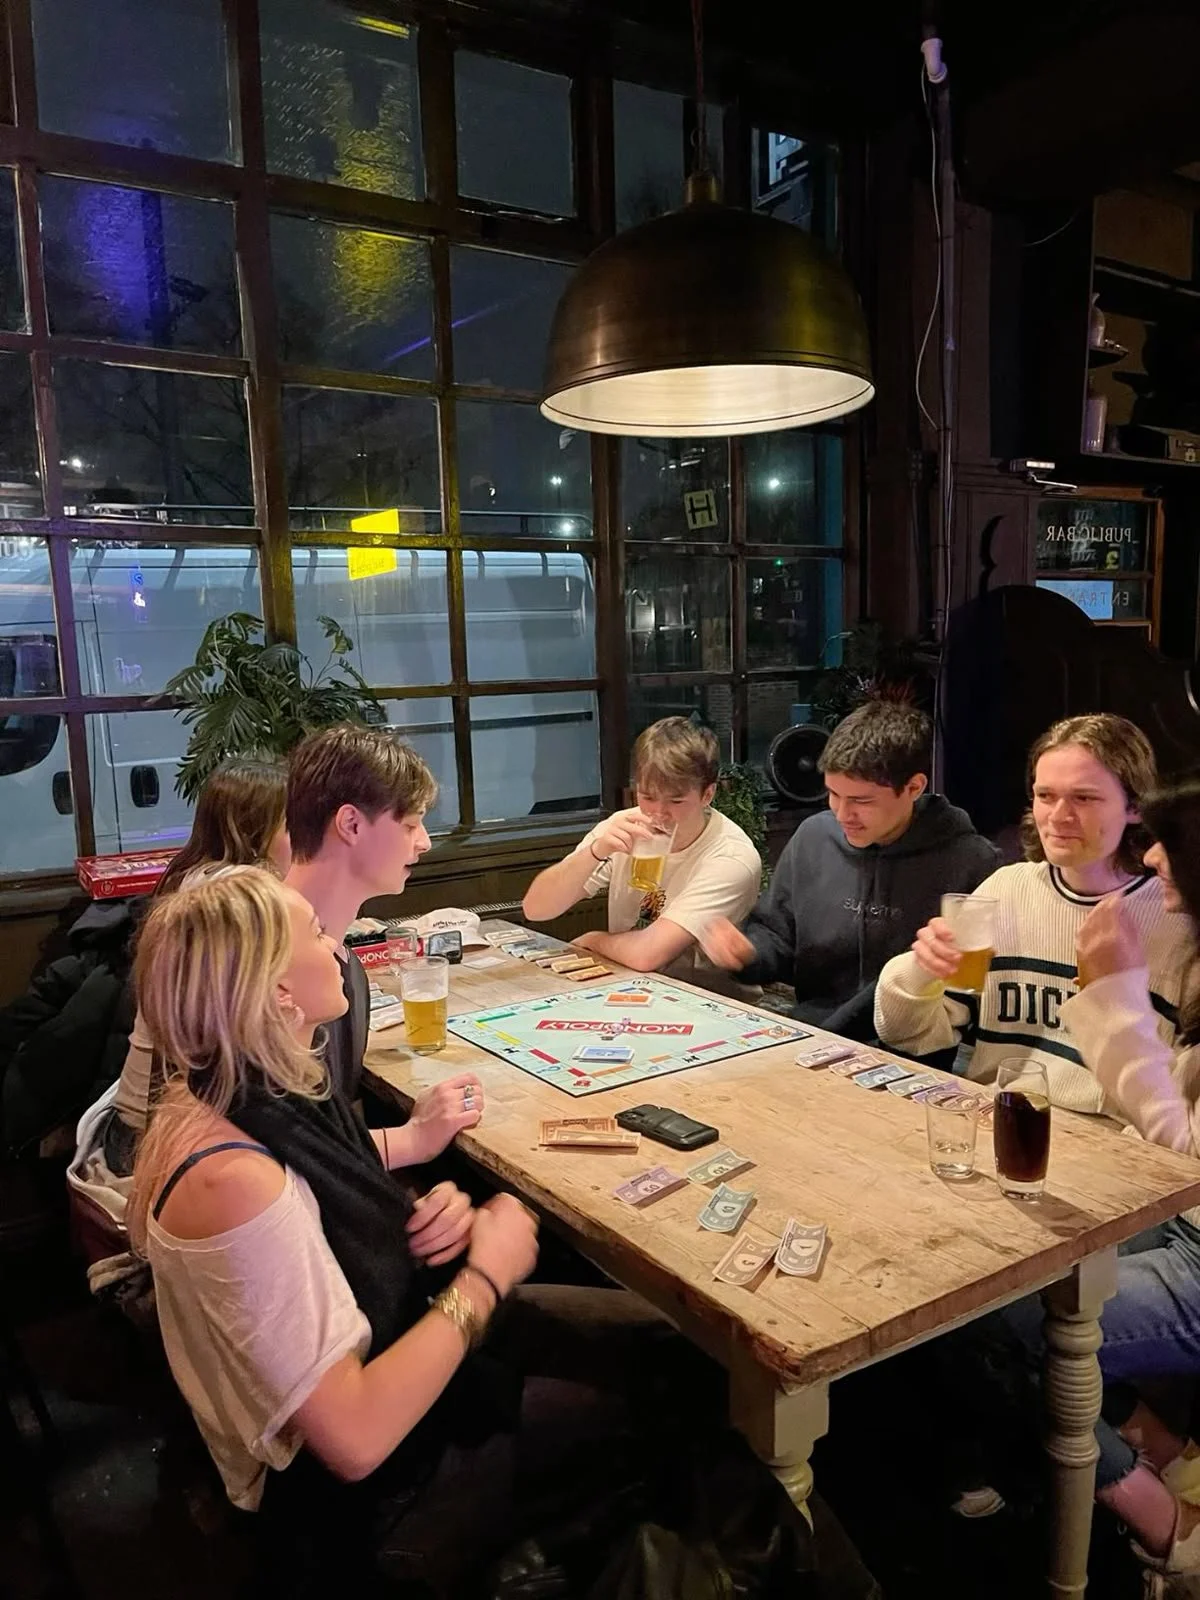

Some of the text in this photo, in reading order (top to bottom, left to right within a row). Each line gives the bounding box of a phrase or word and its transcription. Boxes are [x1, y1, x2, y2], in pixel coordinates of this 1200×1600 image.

[688, 493, 713, 525] H
[997, 981, 1077, 1029] DIC
[541, 1021, 688, 1035] MONOPOLY
